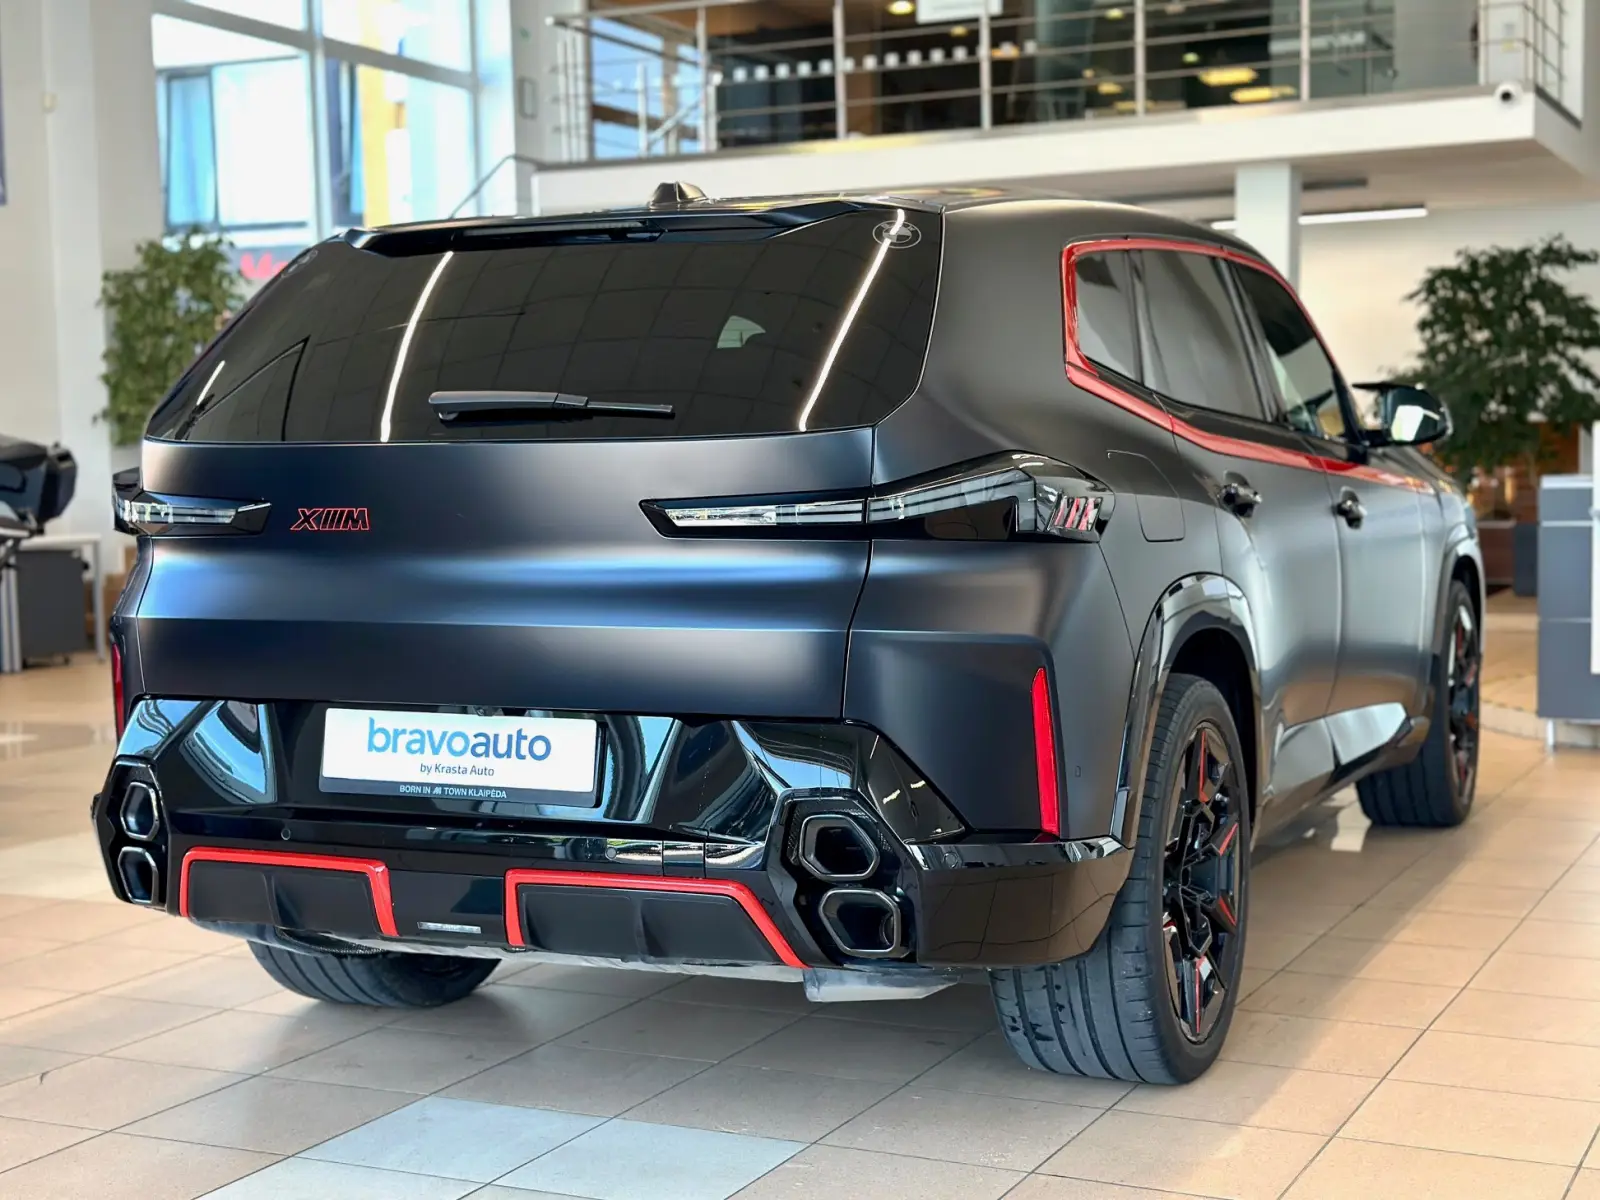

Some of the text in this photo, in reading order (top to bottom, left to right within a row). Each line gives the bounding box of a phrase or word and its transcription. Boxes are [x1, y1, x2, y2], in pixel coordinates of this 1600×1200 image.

[367, 717, 552, 762] bravoauto
[420, 763, 495, 777] by Krasta Auto
[399, 784, 421, 794] BORN
[422, 786, 431, 795] IN
[443, 786, 467, 797] TOWN
